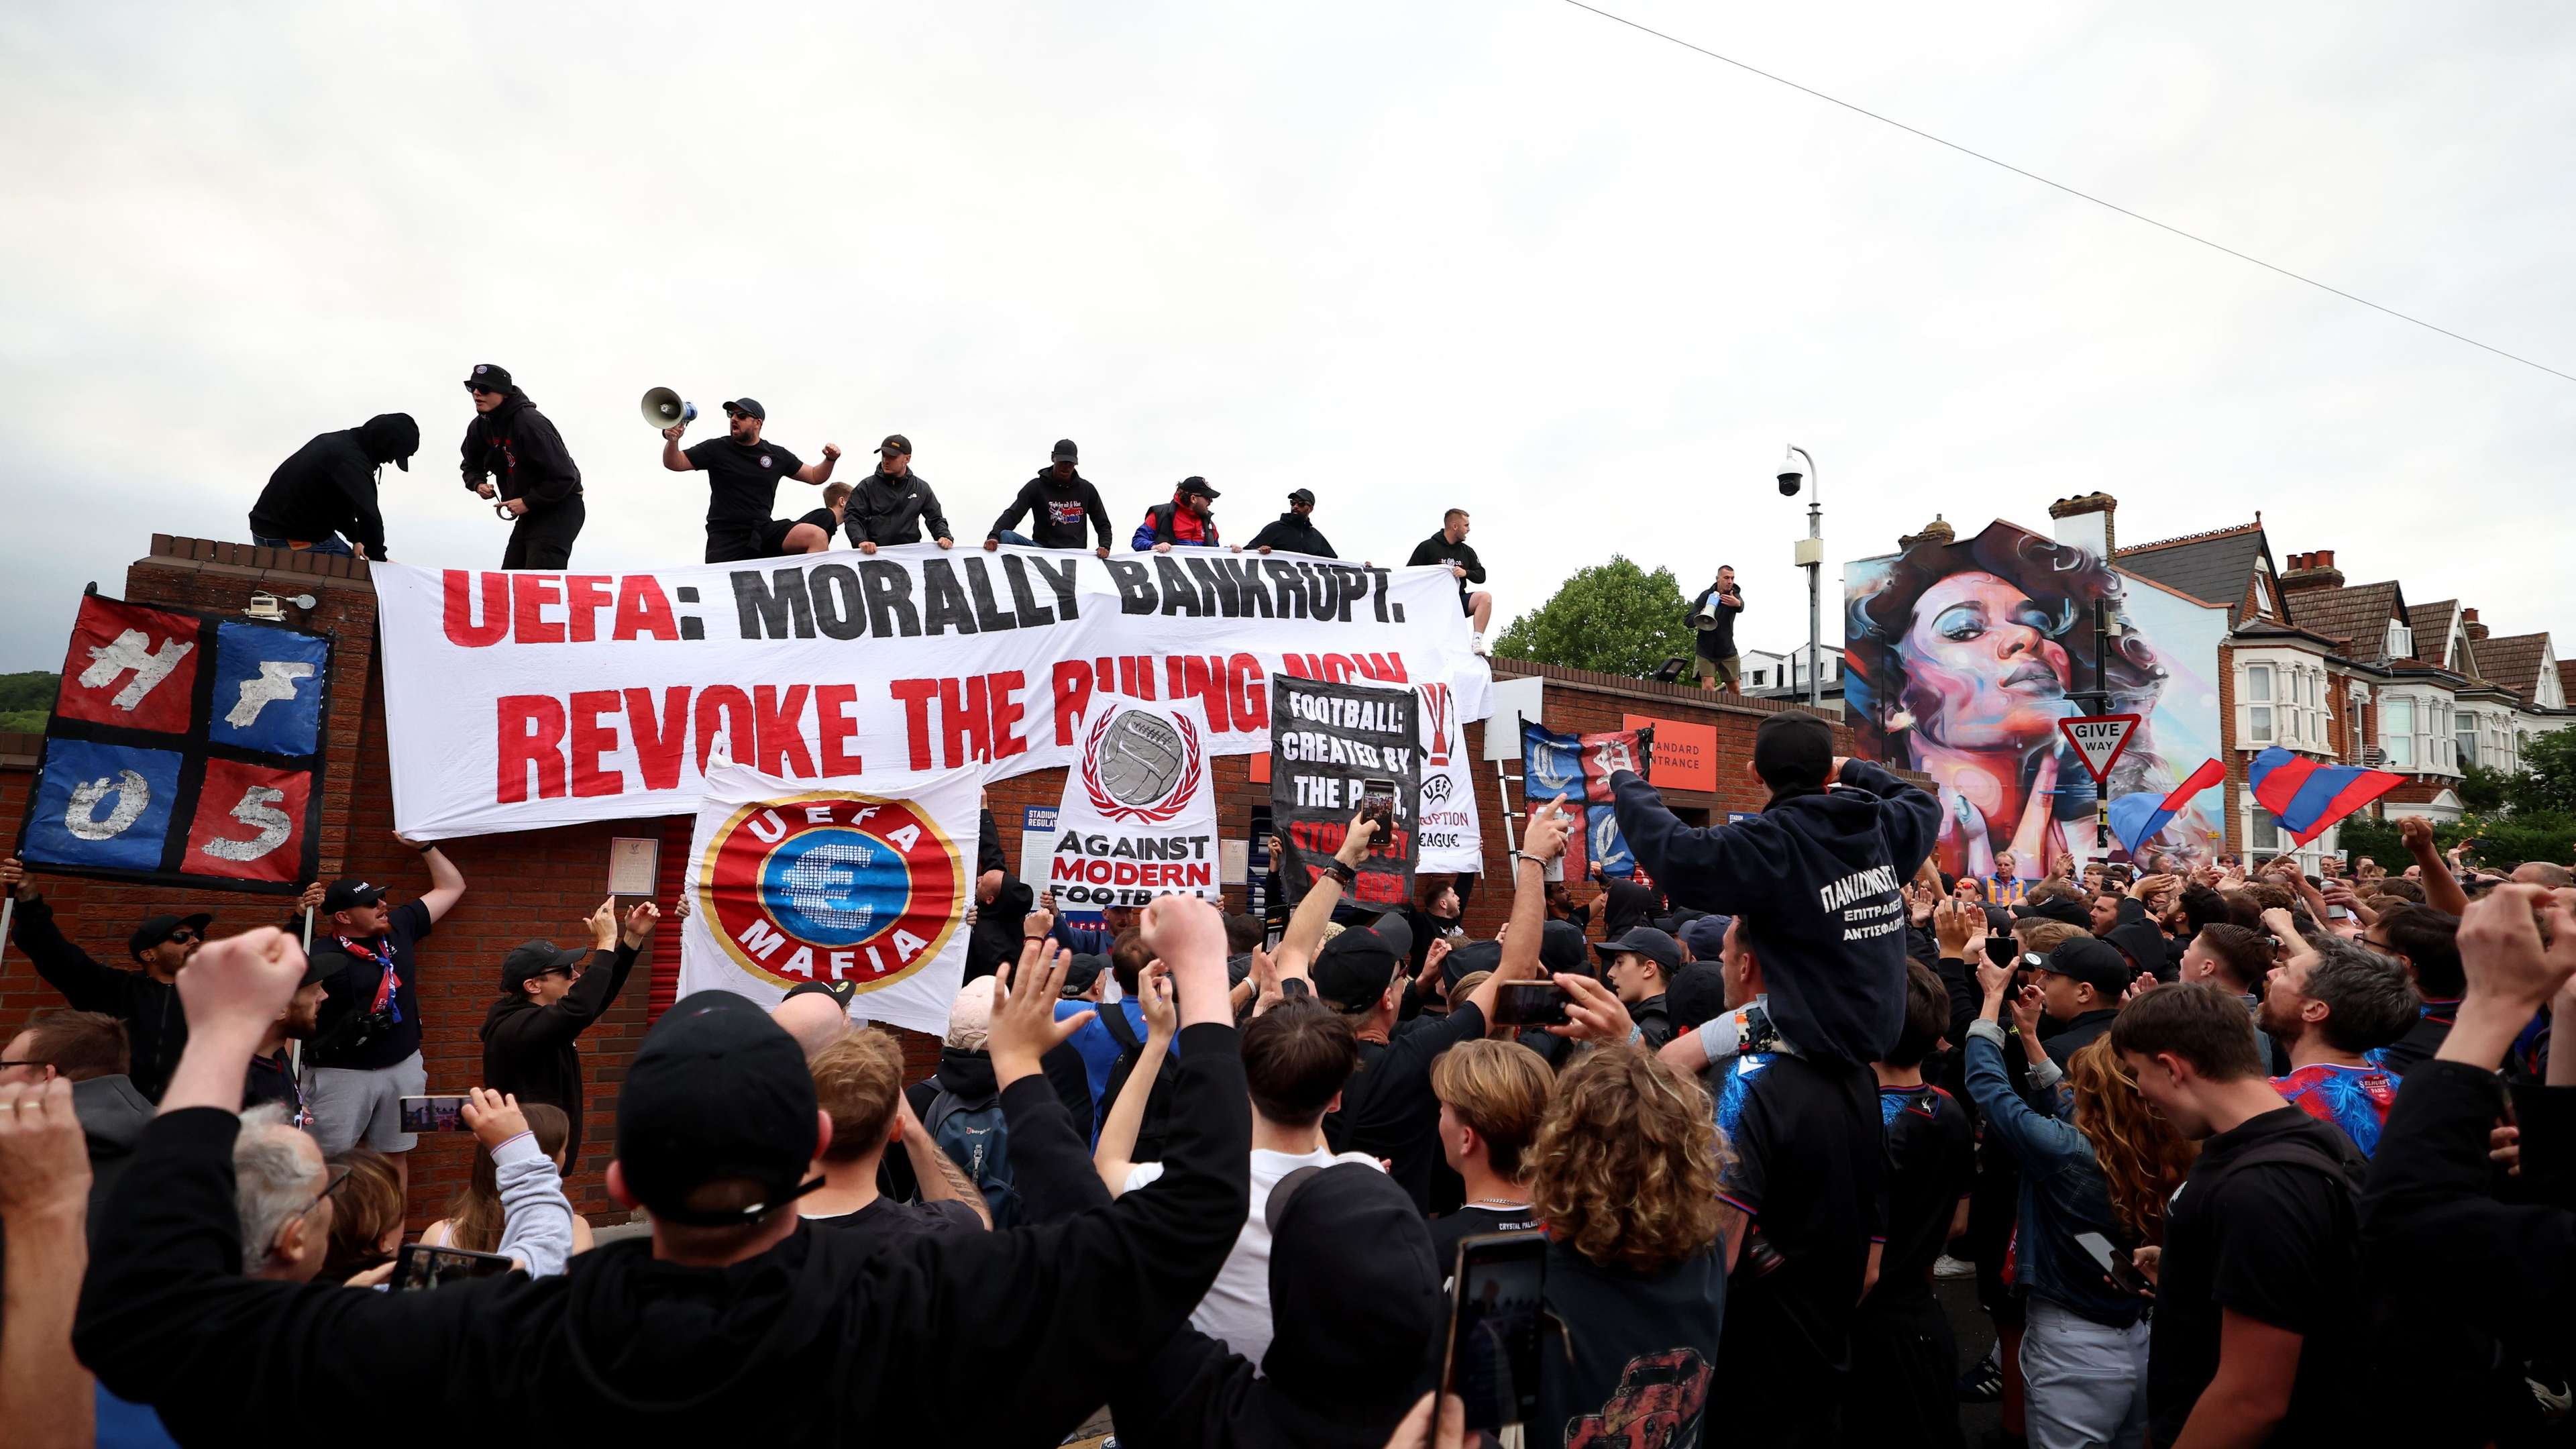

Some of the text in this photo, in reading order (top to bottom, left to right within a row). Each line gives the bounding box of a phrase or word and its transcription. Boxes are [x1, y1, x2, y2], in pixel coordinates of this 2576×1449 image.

[443, 553, 1405, 647] UEFA: MORALLY BANKRUPT.
[1289, 690, 1403, 734] FOOTBALL:
[497, 684, 861, 804] REVOKE
[891, 669, 1027, 771] THE
[2075, 723, 2120, 738] GIVE
[2085, 741, 2113, 751] WAY
[1281, 732, 1411, 775] CREATED BY
[1651, 755, 1699, 769] NTRANCE
[1655, 741, 1699, 755] ANDARD
[1293, 775, 1340, 809] THE
[747, 805, 922, 853] UEFA
[1028, 810, 1057, 819] STADIUM
[1028, 818, 1057, 827] REGULAT
[1054, 830, 1210, 861] AGAINST
[1051, 857, 1211, 887] MODERN
[738, 918, 929, 980] MAFIA
